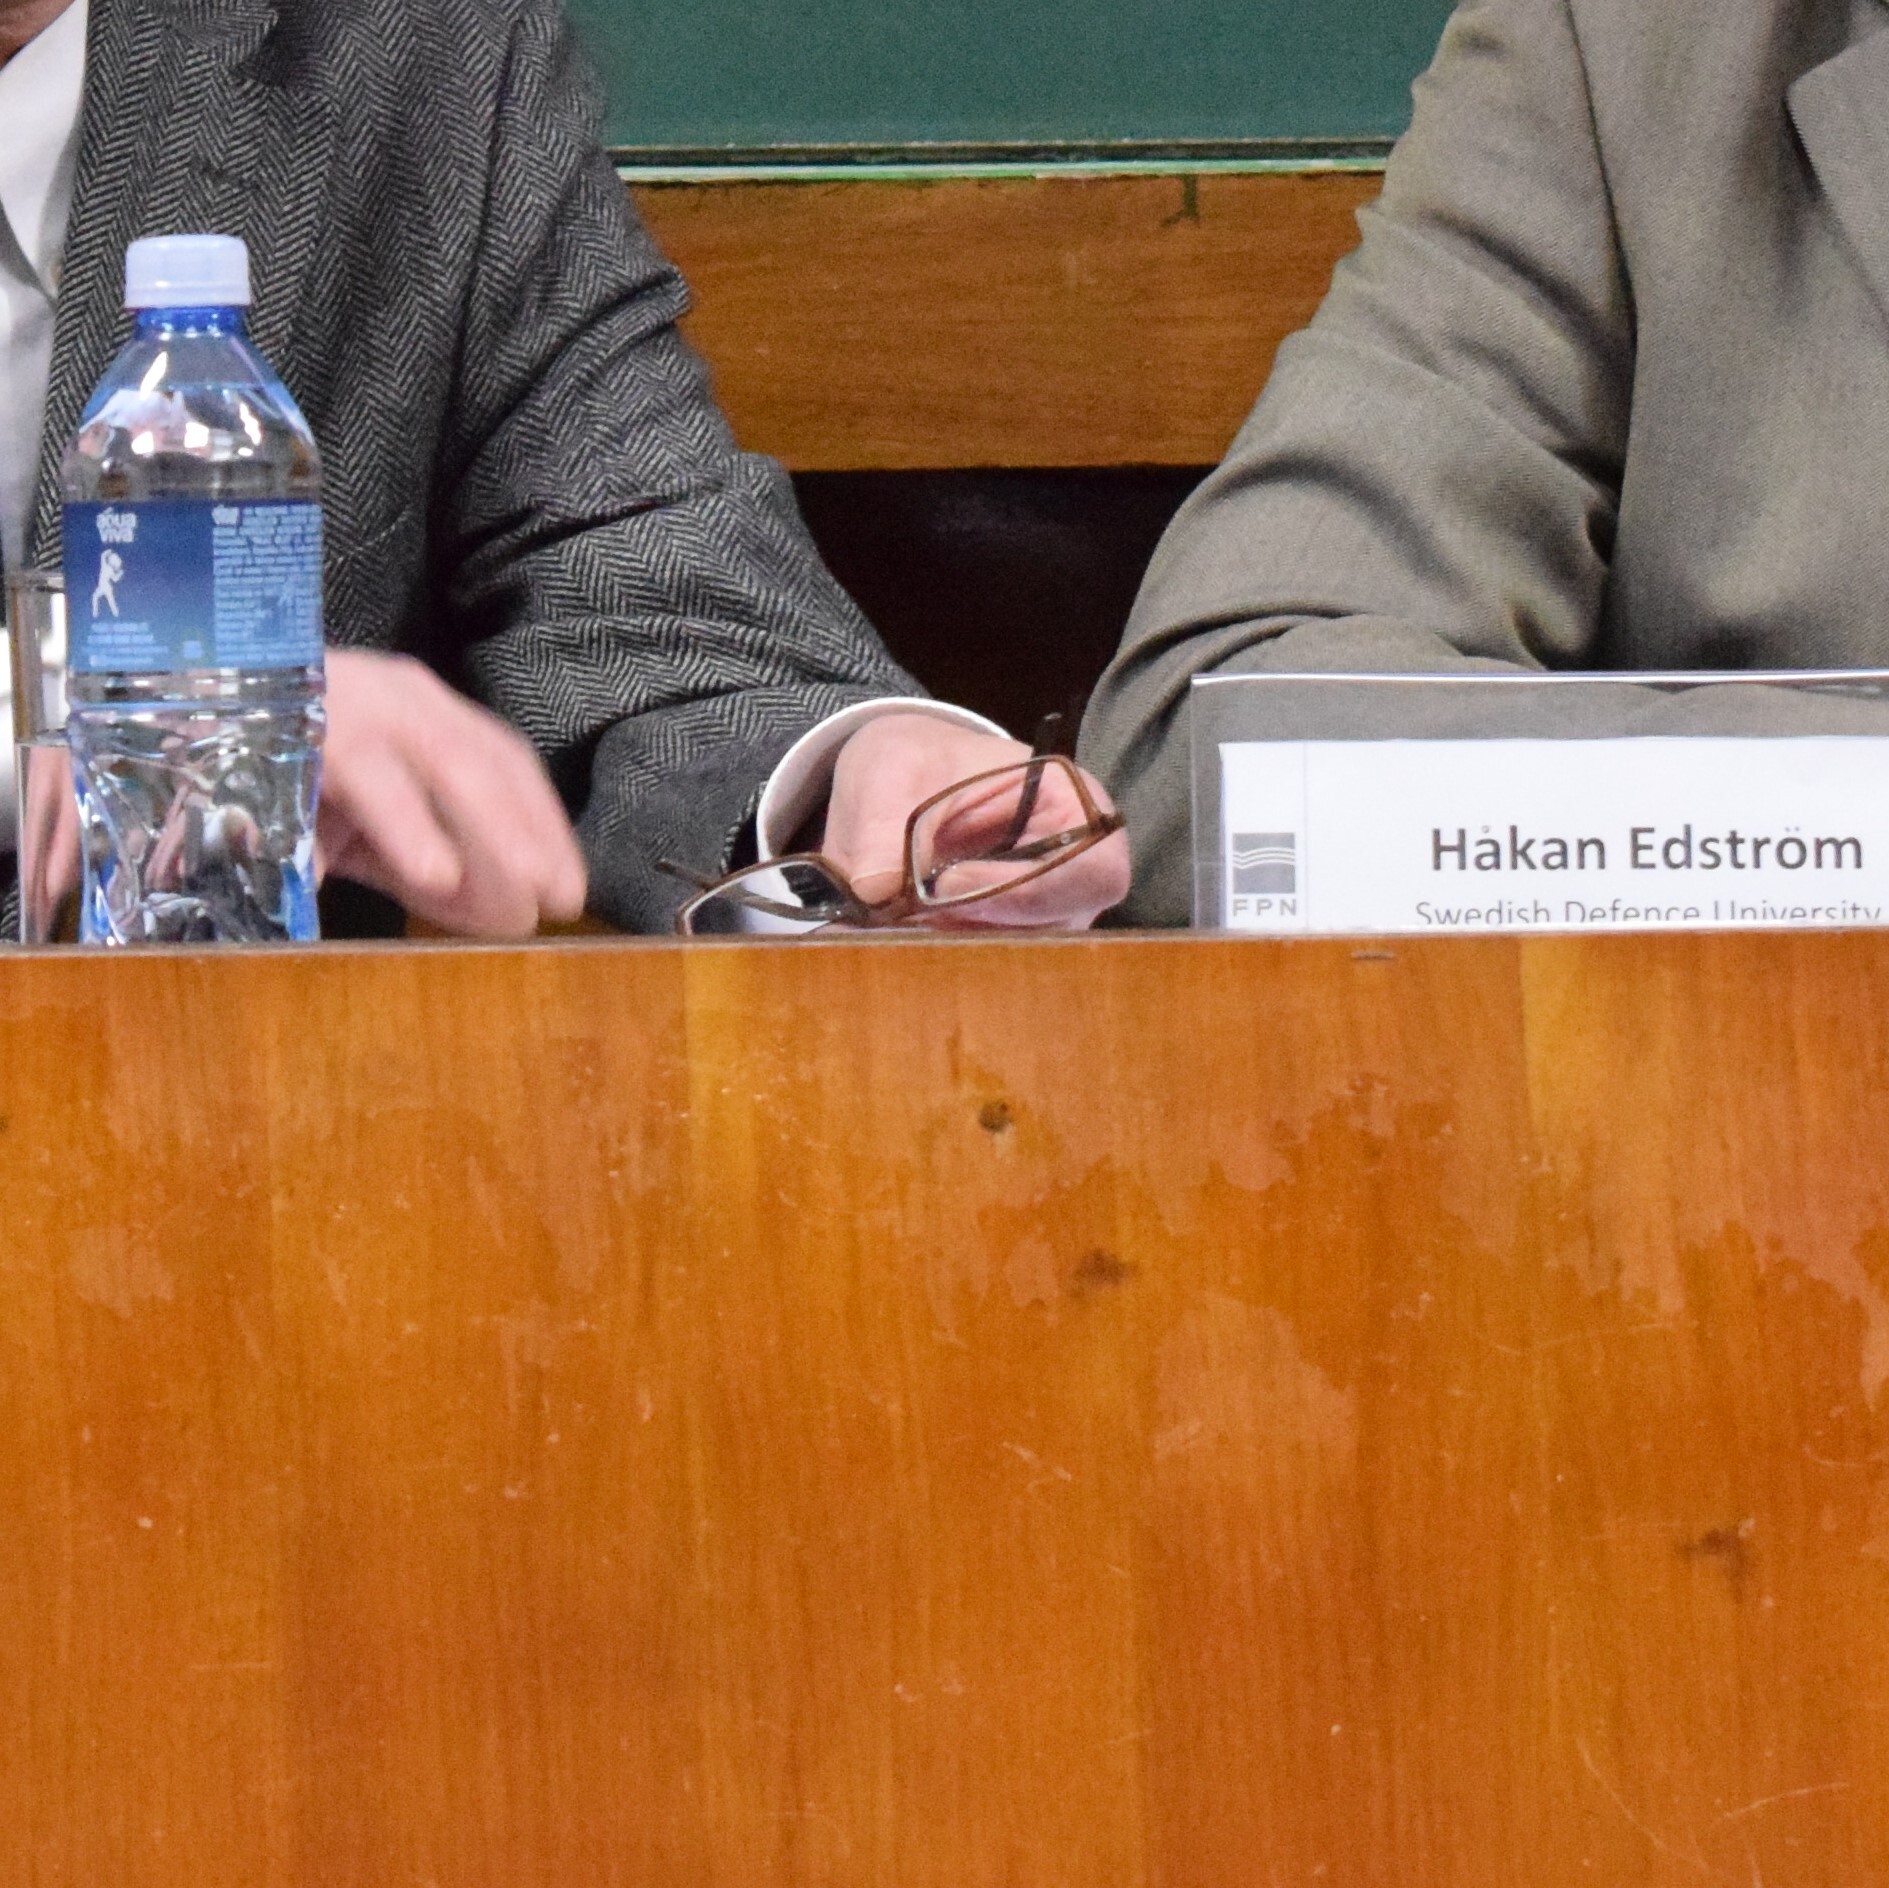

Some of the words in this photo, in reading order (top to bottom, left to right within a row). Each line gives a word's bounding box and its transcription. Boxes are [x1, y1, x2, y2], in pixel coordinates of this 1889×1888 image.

[1432, 825, 1606, 871] Håkan
[1629, 824, 1863, 870] Edström
[1233, 899, 1296, 916] FPN
[1416, 899, 1550, 924] Swedish
[1565, 898, 1700, 922] Defence
